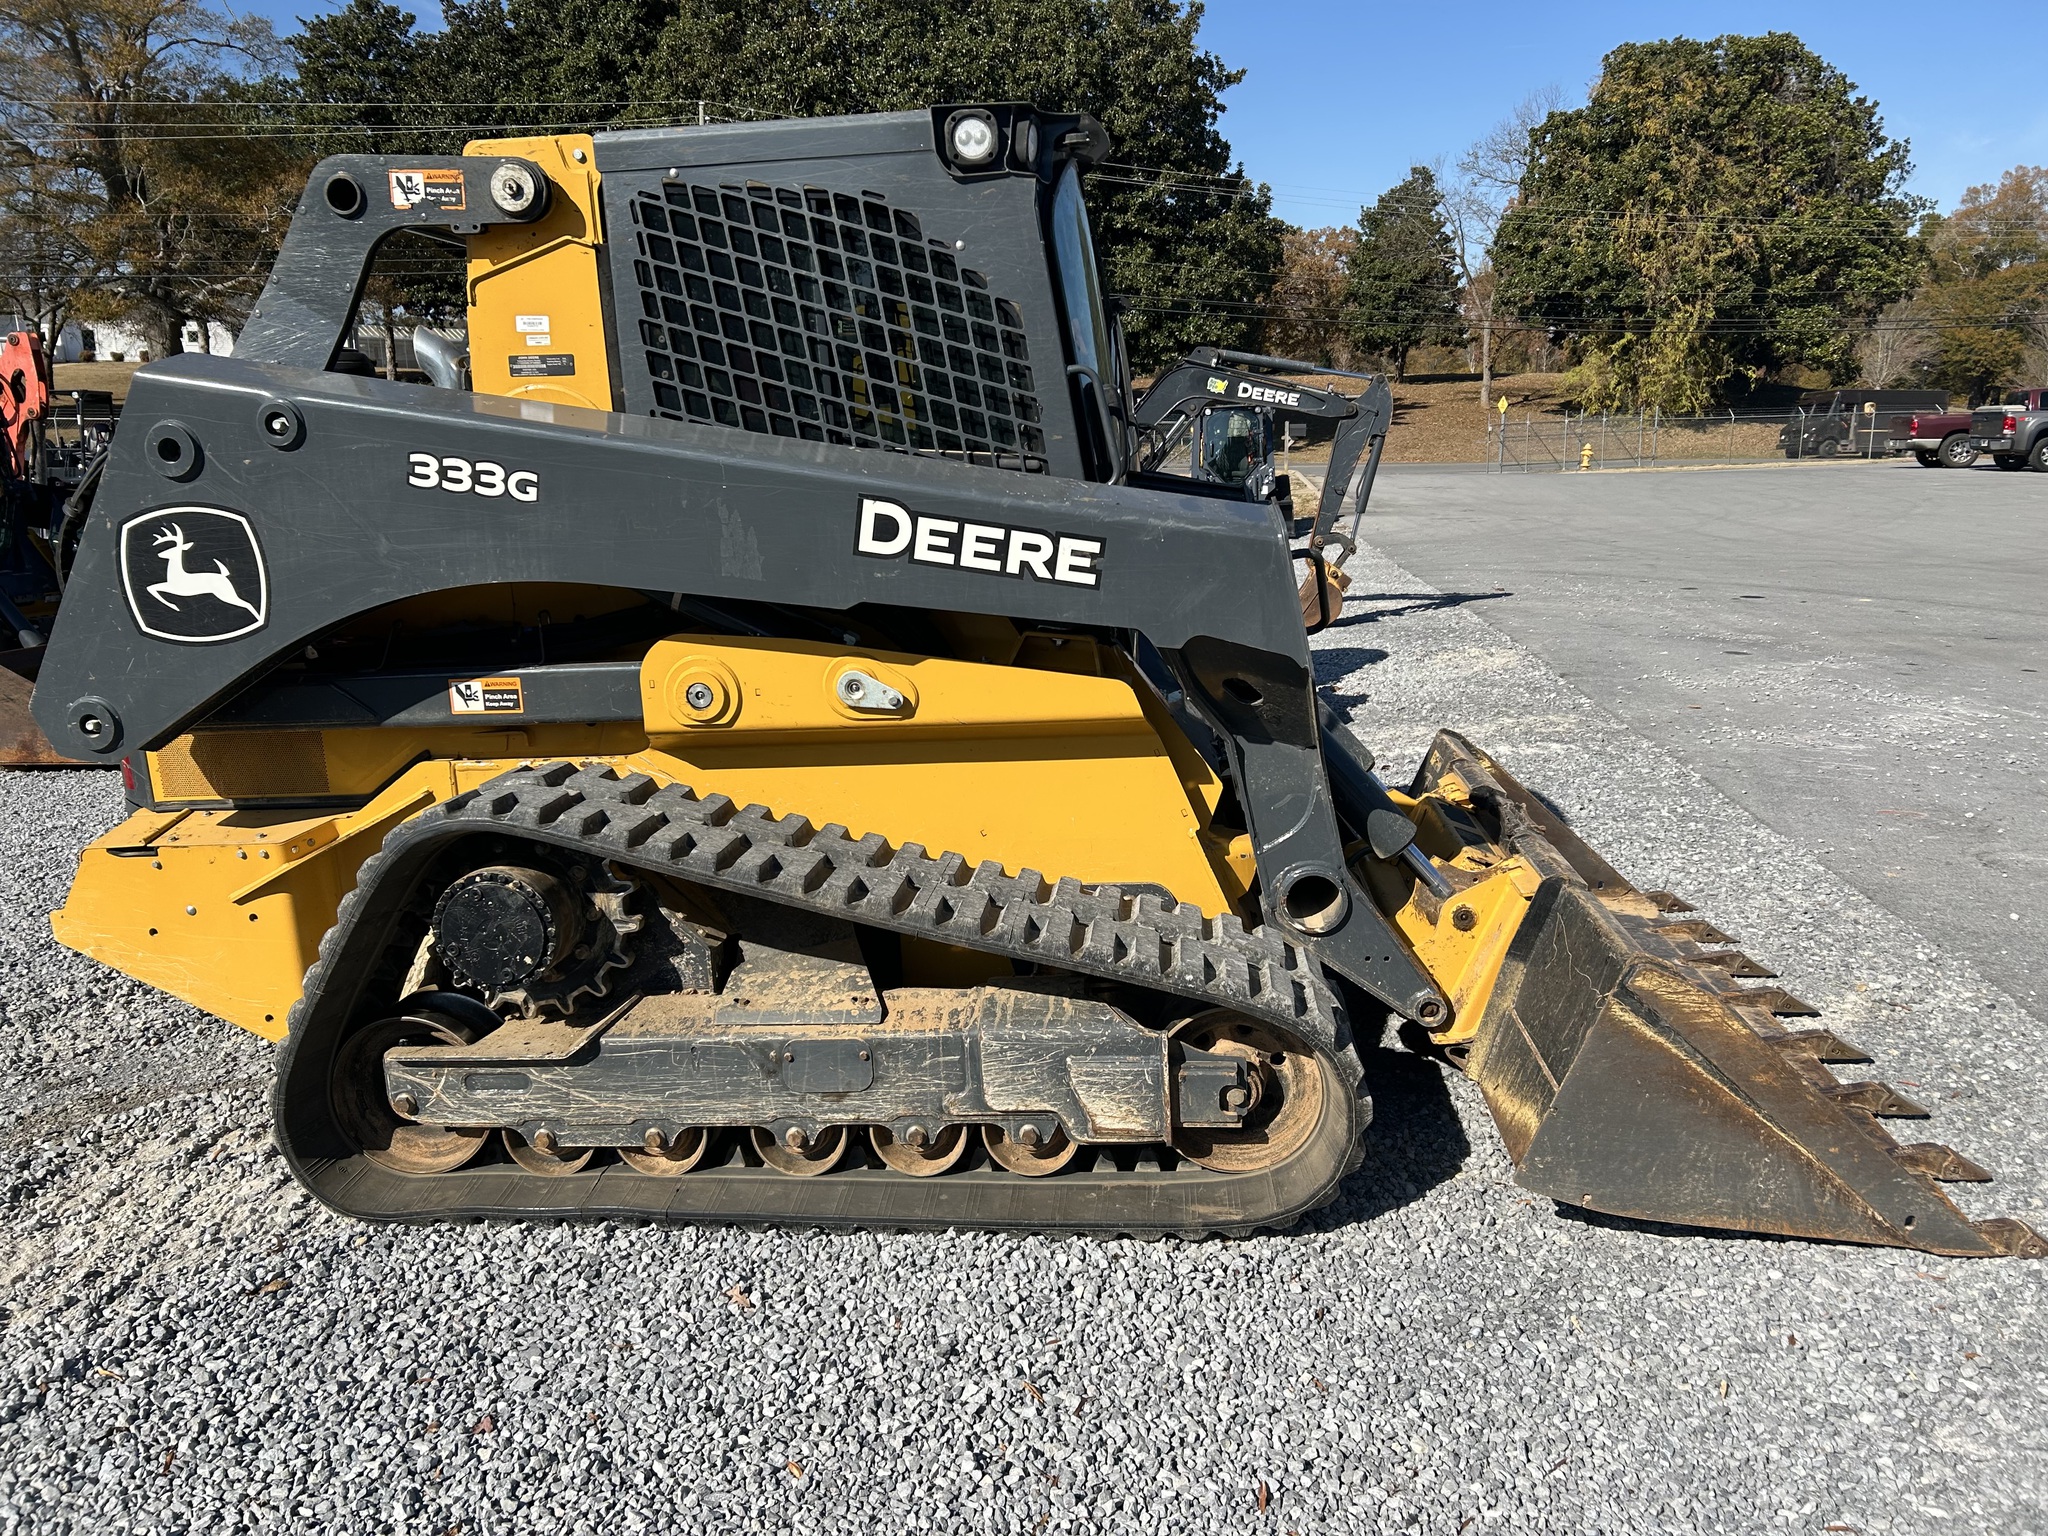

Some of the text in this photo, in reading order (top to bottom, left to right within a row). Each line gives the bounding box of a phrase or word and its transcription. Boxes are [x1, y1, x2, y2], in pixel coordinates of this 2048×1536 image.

[1237, 382, 1300, 406] DEERE
[408, 452, 538, 502] 333G
[857, 497, 1102, 587] DEERE
